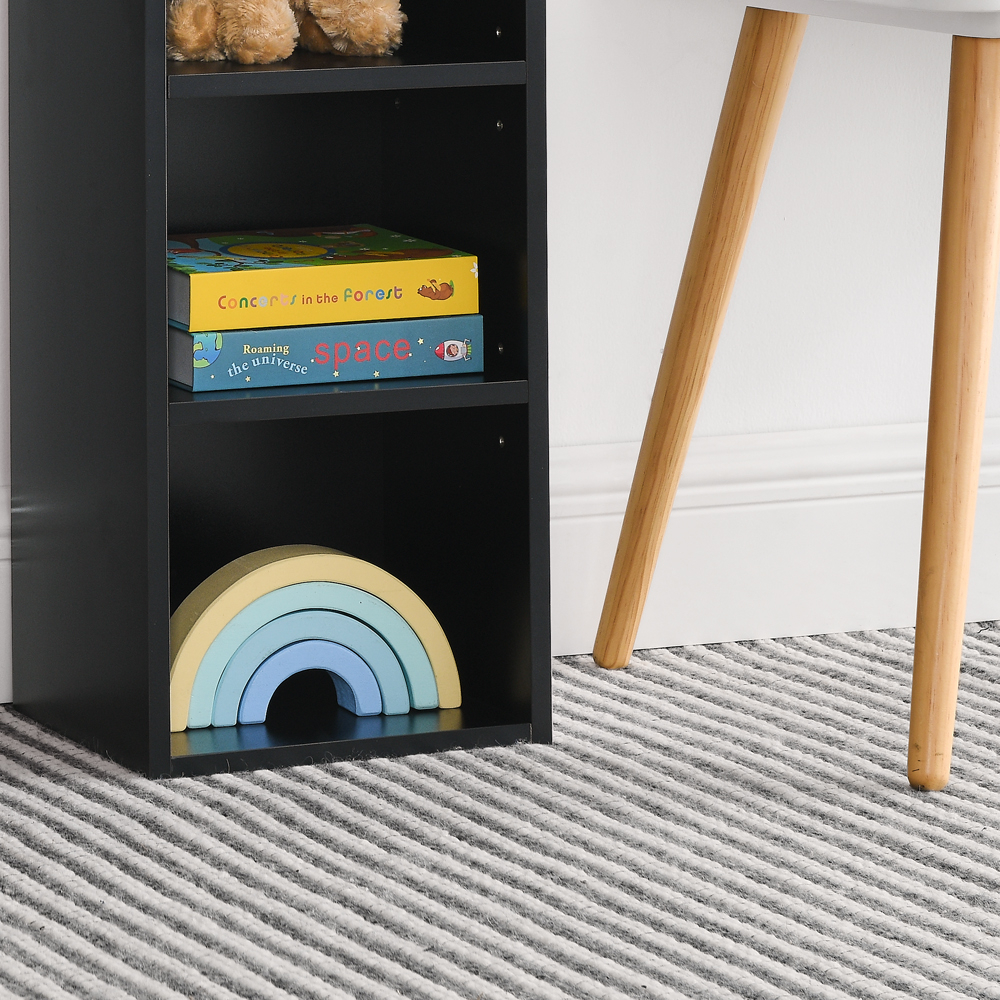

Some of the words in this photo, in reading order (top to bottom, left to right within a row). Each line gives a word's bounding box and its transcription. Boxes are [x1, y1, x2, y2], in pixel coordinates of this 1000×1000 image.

[218, 295, 297, 310] Concerts
[302, 295, 312, 304] in
[316, 292, 338, 304] the
[243, 343, 290, 355] Roaming
[315, 339, 411, 370] space
[227, 362, 250, 377] the
[251, 353, 308, 375] universe
